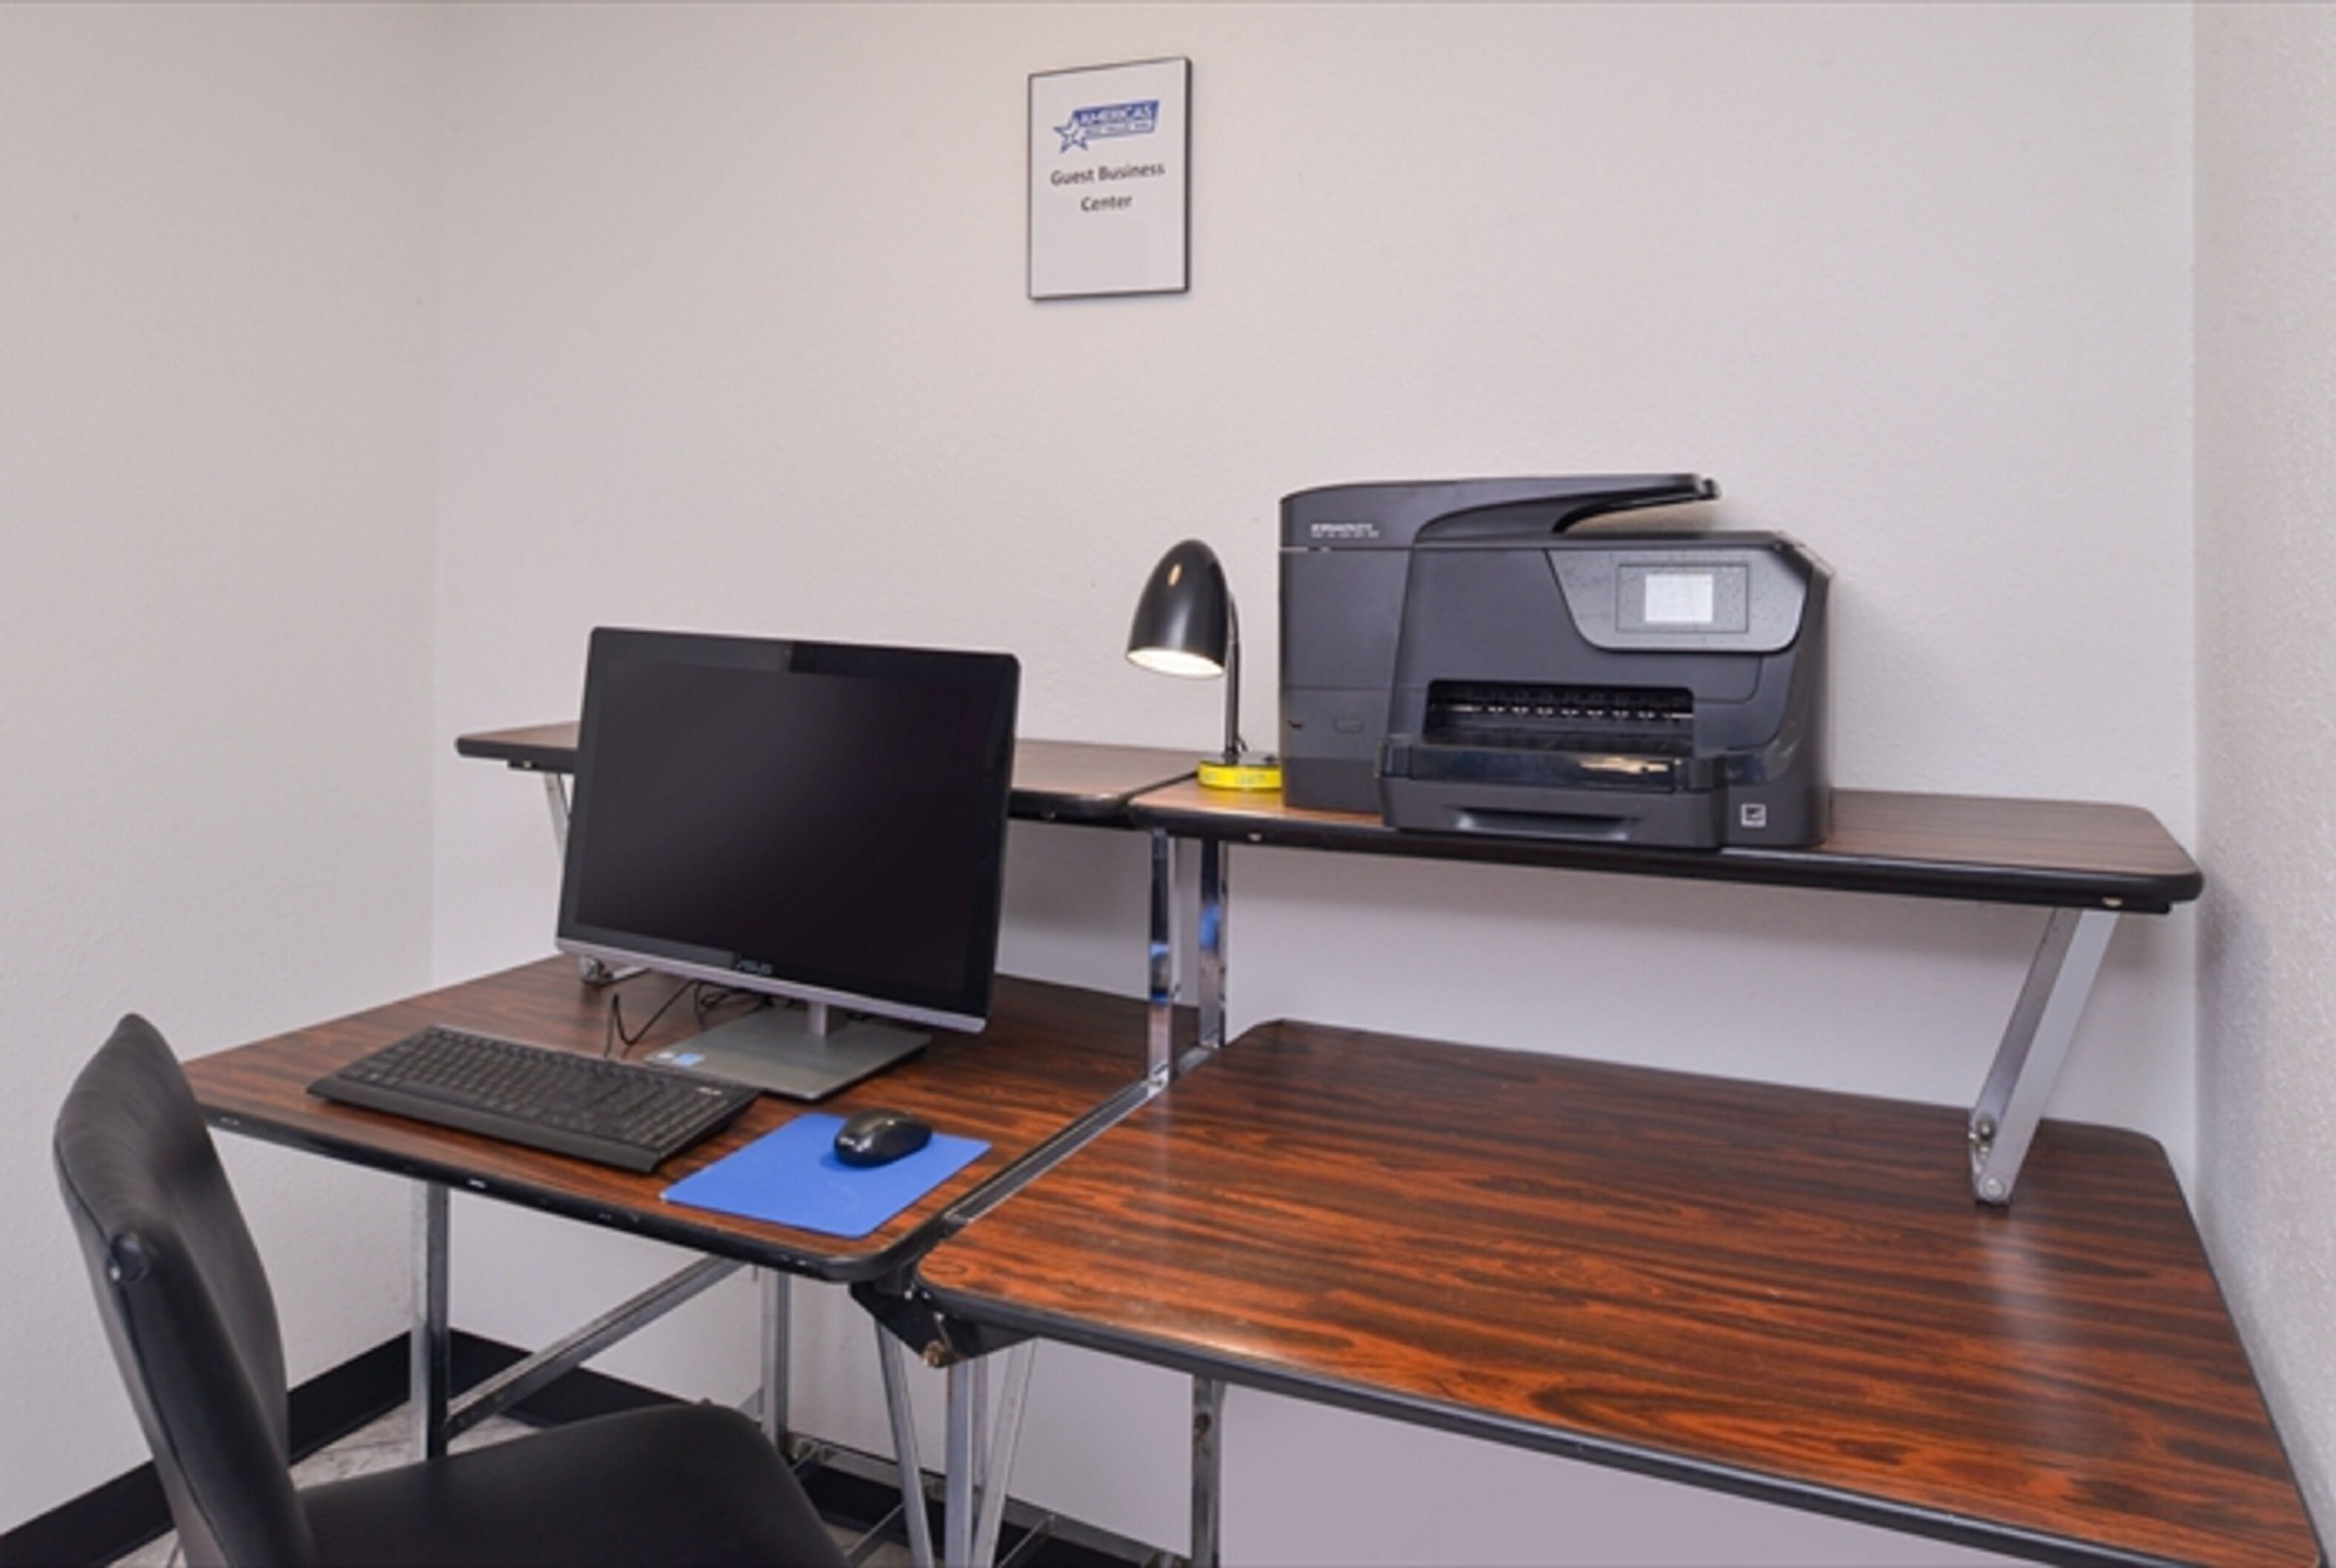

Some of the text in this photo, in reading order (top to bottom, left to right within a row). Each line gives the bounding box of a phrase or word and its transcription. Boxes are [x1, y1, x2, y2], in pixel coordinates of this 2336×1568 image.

[1051, 163, 1165, 185] Guest Business
[1080, 196, 1132, 212] Center
